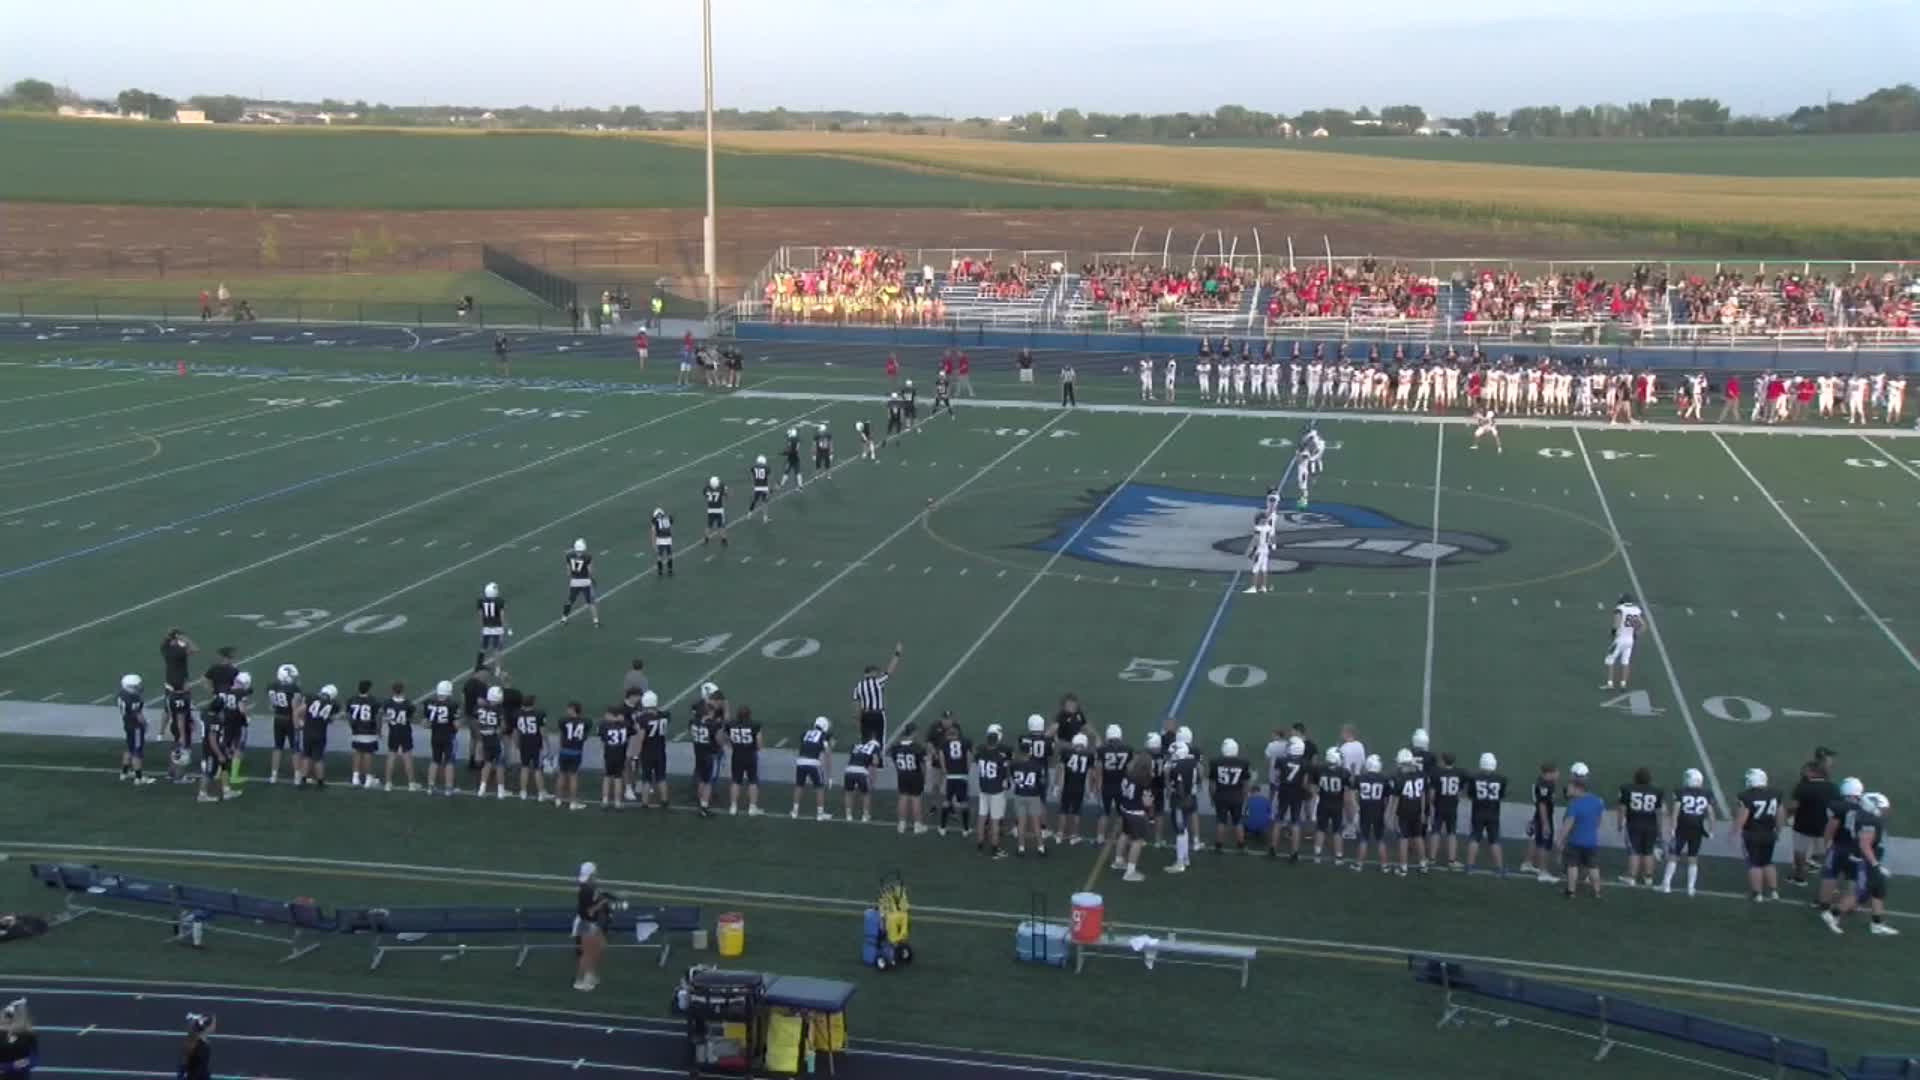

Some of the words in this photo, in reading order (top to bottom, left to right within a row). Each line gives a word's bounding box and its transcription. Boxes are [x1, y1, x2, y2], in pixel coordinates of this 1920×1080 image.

[483, 602, 495, 617] 11
[1117, 657, 1268, 688] 50
[308, 700, 332, 719] 44
[350, 704, 371, 720] 76
[427, 705, 448, 723] 72
[1600, 690, 1773, 723] 40
[517, 716, 537, 734] 45
[565, 722, 584, 740] 14
[607, 728, 627, 745] 31
[950, 740, 961, 759] 8
[1067, 754, 1088, 773] 41
[1104, 752, 1128, 770] 27
[1217, 766, 1242, 784] 57
[1286, 762, 1300, 780] 7
[1360, 782, 1383, 799] 20
[1440, 776, 1459, 795] 16
[1476, 781, 1500, 799] 53
[1682, 796, 1707, 814] 22
[1753, 798, 1776, 818] 74
